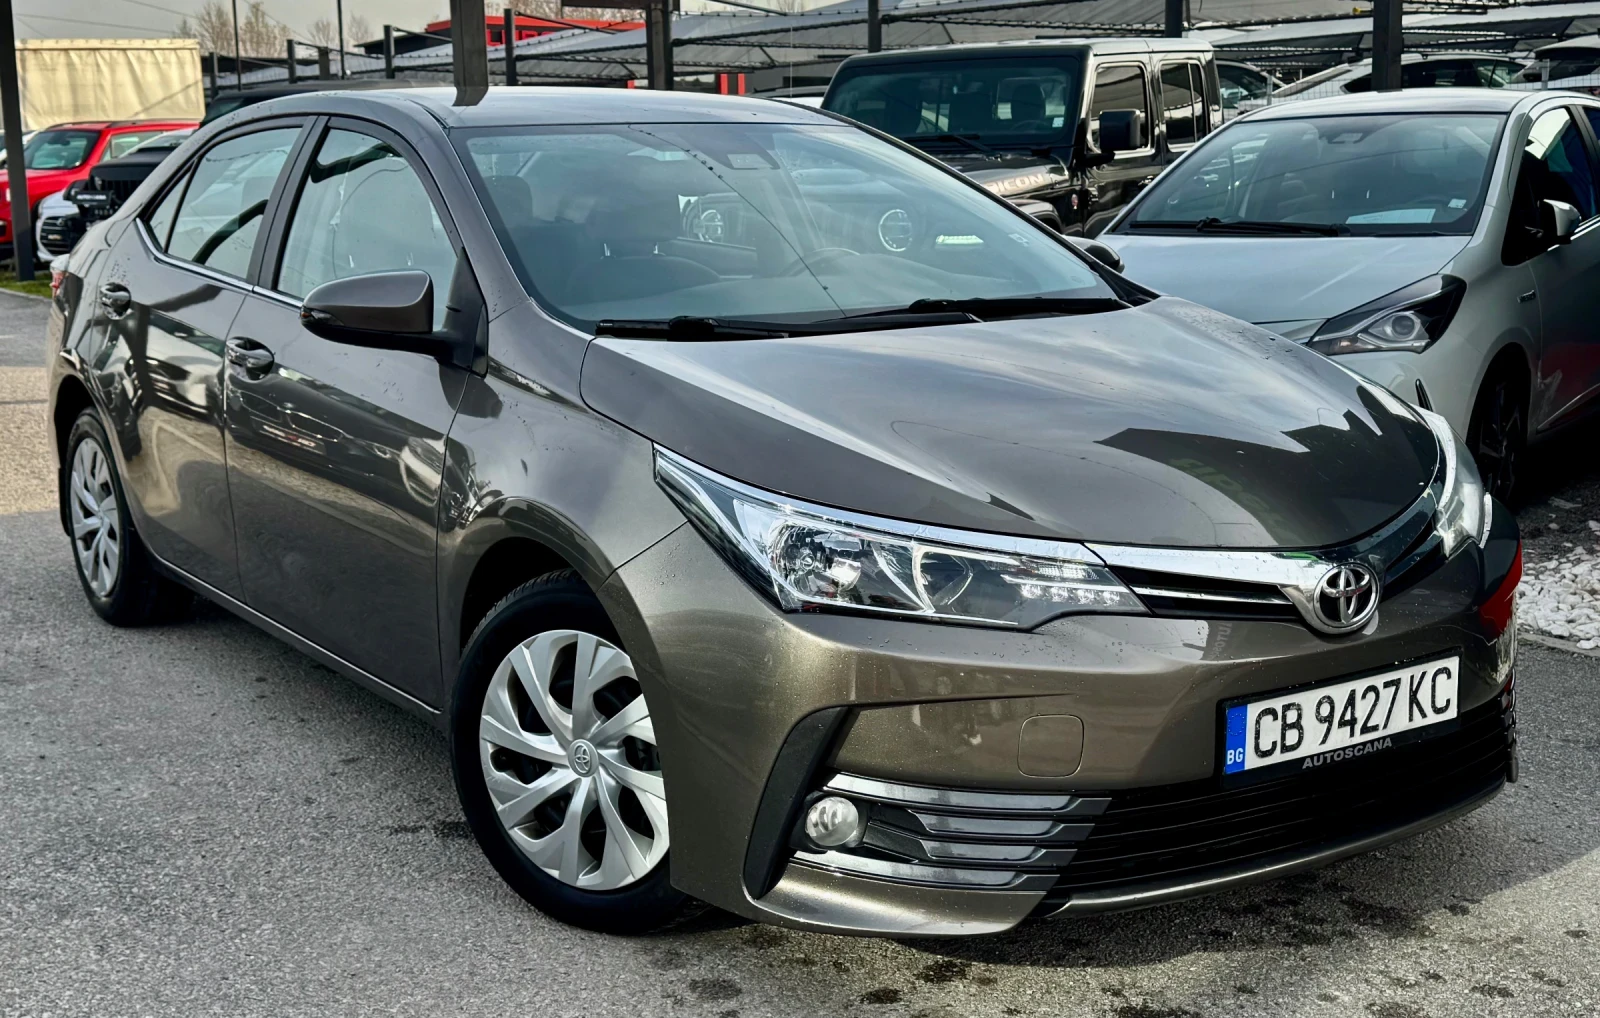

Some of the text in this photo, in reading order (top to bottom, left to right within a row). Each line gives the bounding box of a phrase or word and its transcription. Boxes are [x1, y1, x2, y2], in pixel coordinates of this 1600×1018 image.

[1253, 666, 1453, 759] CB 9427 KC
[1226, 747, 1244, 765] BG
[1302, 737, 1393, 770] AUTOSCANA
